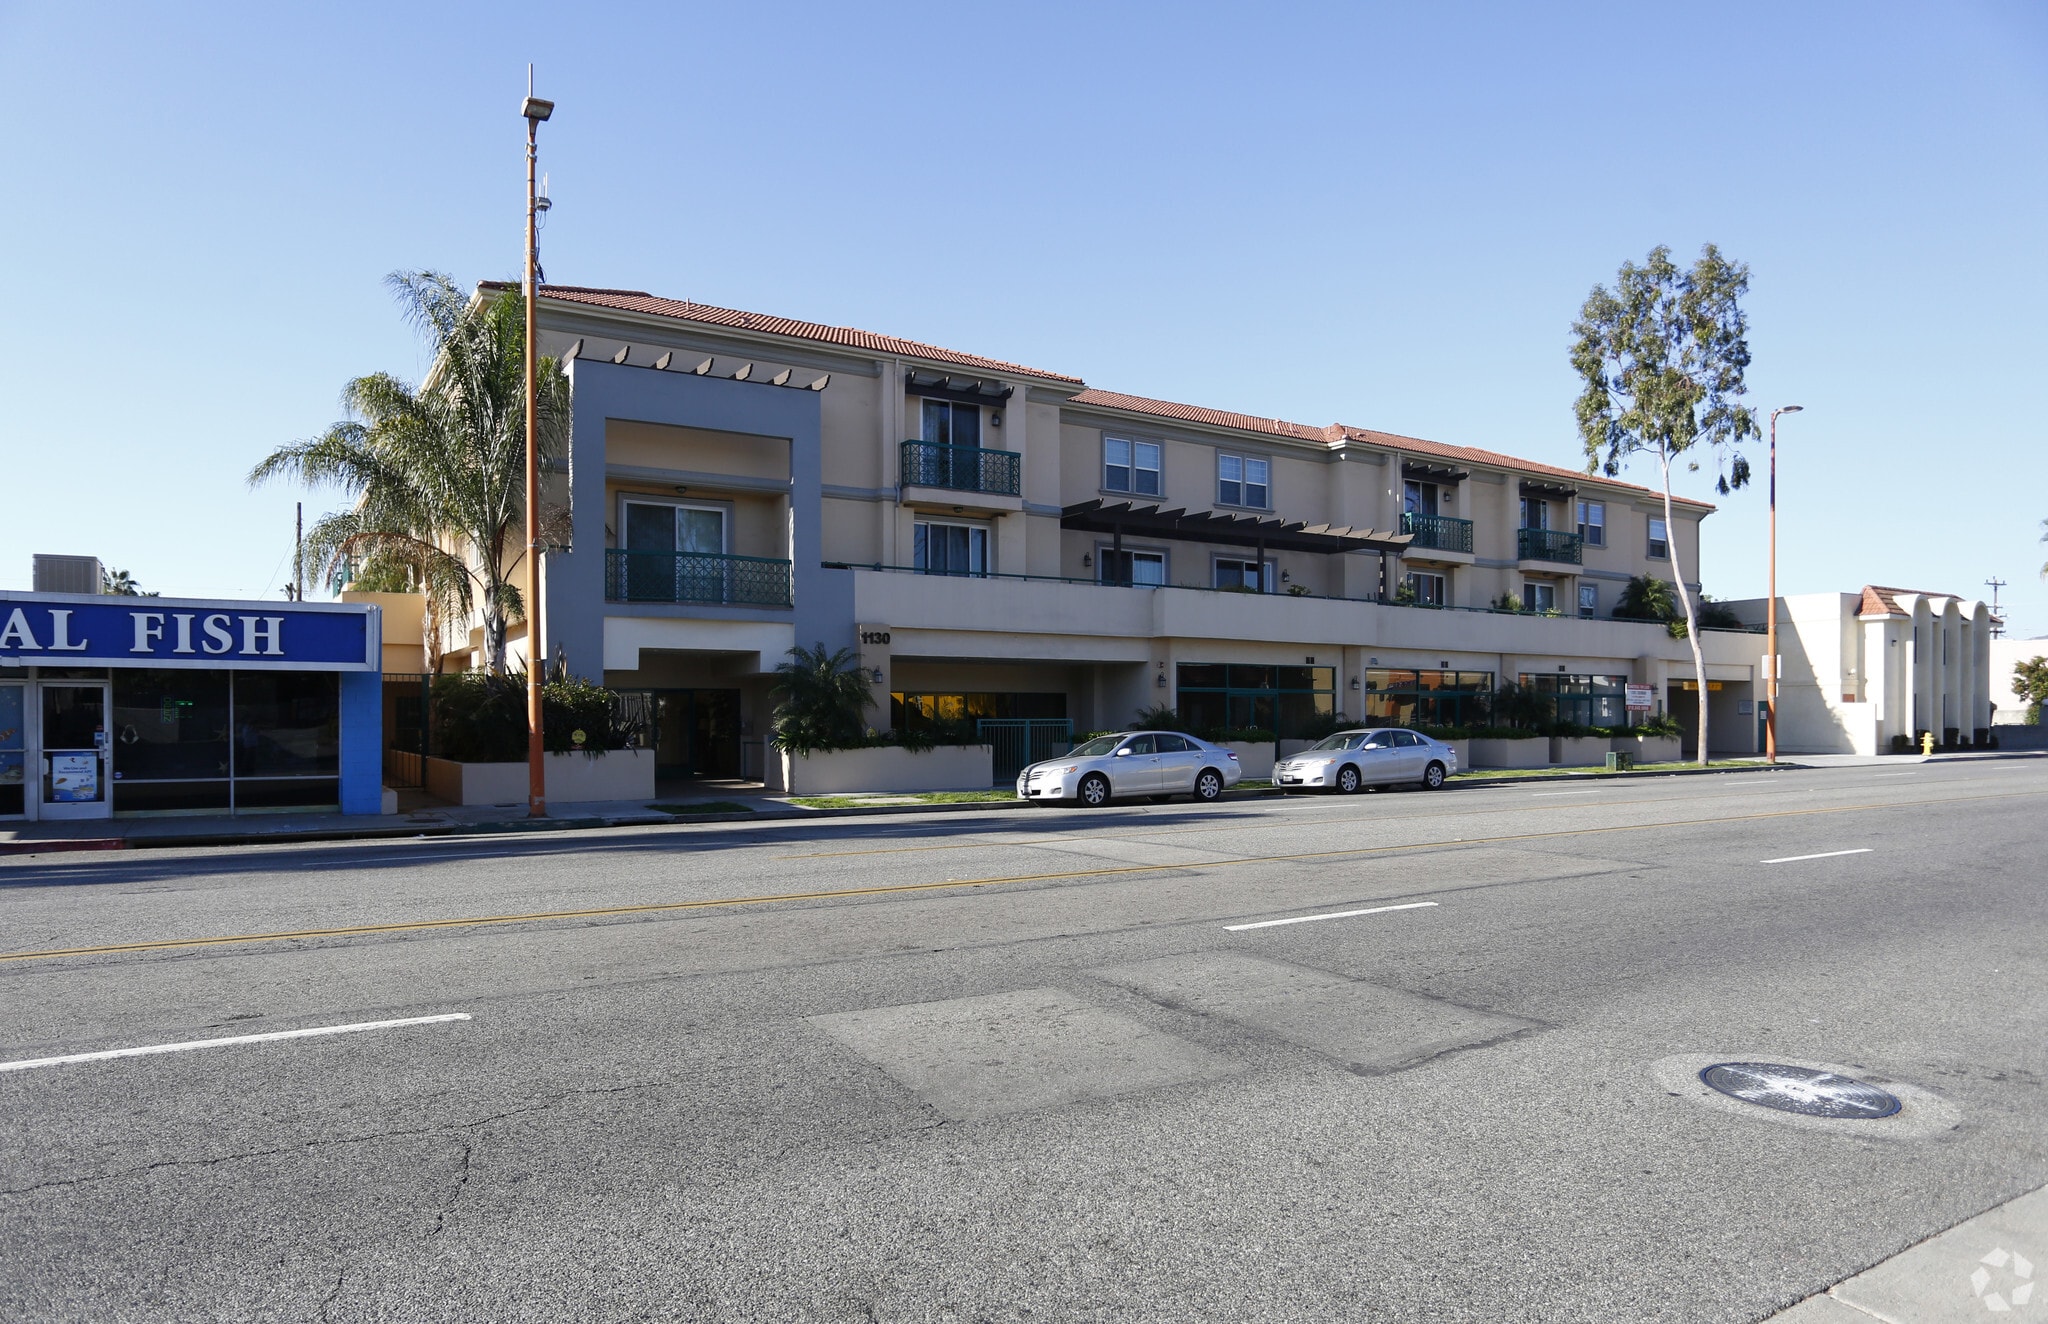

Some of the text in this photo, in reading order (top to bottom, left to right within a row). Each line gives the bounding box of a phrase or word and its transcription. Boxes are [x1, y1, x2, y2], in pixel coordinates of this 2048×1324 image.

[0, 607, 285, 655] AL FISH
[861, 631, 891, 645] 1130
